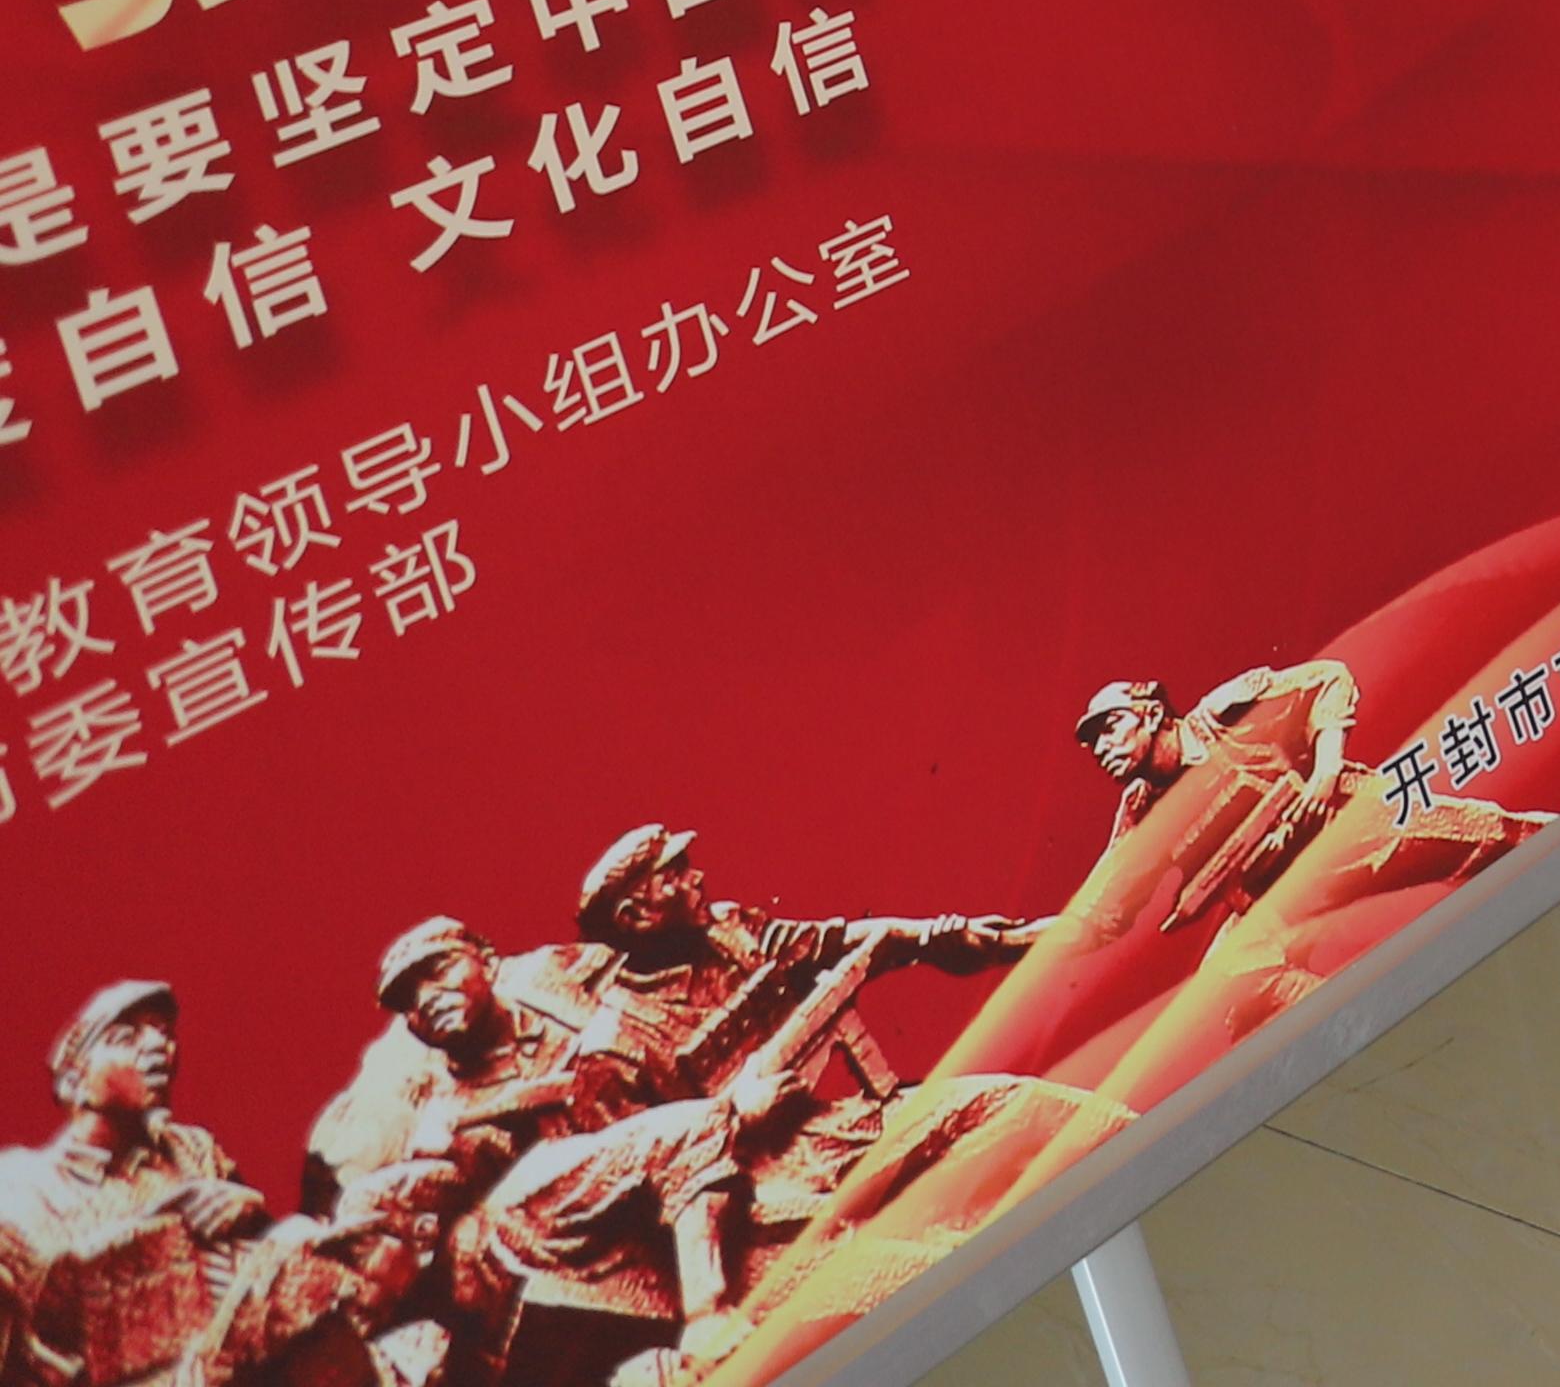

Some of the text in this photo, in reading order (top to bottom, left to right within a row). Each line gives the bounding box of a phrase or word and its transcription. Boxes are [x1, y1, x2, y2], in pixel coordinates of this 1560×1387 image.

[0, 6, 871, 447] 自信 文化自信
[0, 213, 911, 697] 教育领导小组办公室
[0, 518, 477, 824] 委宣传部
